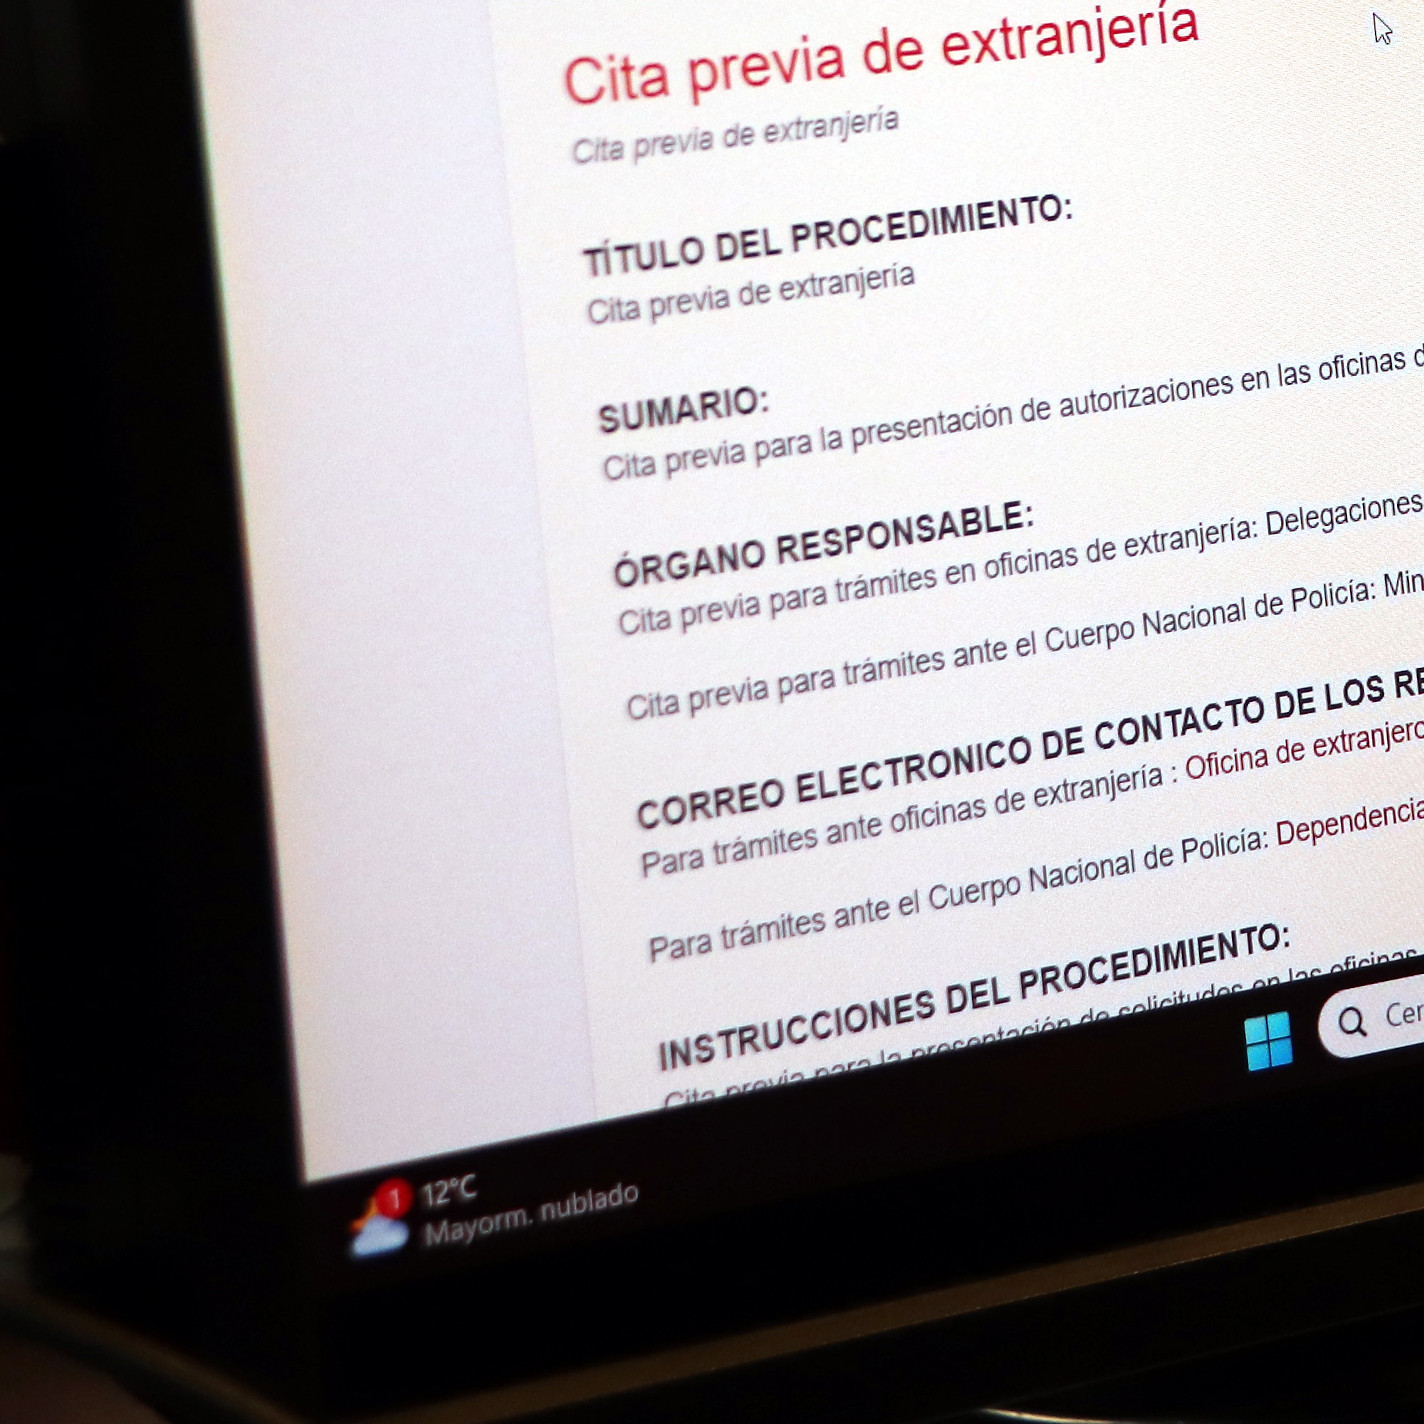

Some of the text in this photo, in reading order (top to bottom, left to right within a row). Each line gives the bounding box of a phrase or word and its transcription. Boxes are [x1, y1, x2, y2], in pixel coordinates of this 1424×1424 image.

[564, 53, 669, 106] Cita
[688, 35, 845, 107] previa
[863, 26, 924, 75] de
[582, 193, 1072, 277] TÍTULO DEL PROCEDIMIENTO:
[587, 265, 916, 326] Cita previa de extranjería
[598, 385, 769, 435] SUMARIO:
[602, 454, 657, 482] Cita
[664, 443, 747, 480] previa
[754, 433, 813, 468] para
[819, 427, 844, 451] la
[850, 406, 1014, 454] presentación
[1020, 398, 1052, 423] de
[1059, 374, 1235, 418] autorizaciones
[1240, 370, 1271, 392] en
[1277, 363, 1312, 386] las
[1318, 350, 1407, 381] oficinas
[613, 500, 1034, 589] ÓRGANO RESPONSABLE:
[618, 608, 672, 637] Cita
[679, 595, 761, 634] previa
[769, 585, 828, 620] para
[835, 568, 938, 603] trámites
[944, 562, 977, 586] en
[984, 546, 1079, 580] oficinas
[1085, 539, 1117, 564] de
[1124, 516, 1257, 558] extranjería:
[1265, 493, 1424, 536] Delegaciones
[626, 693, 680, 721] Cita
[688, 679, 769, 718] previa
[777, 668, 836, 704] para
[842, 650, 946, 686] trámites
[953, 639, 1008, 669] ante
[1015, 631, 1037, 657] el
[1044, 620, 1135, 652] Cuerpo
[1141, 597, 1247, 637] Nacional
[1253, 593, 1284, 618] de
[1291, 582, 1376, 612] Policía:
[636, 778, 785, 830] CORREO
[795, 735, 1032, 804] ELECTRONICO
[1042, 725, 1085, 760] DE
[1094, 695, 1265, 750] CONTACTO
[1274, 685, 1316, 720] DE
[1324, 674, 1386, 711] LOS
[641, 848, 705, 879] Para
[712, 828, 819, 866] trámites
[826, 816, 883, 846] ante
[889, 798, 987, 834] oficinas
[994, 789, 1025, 815] de
[1033, 767, 1163, 808] extranjería
[1185, 747, 1269, 780] Oficina
[1275, 739, 1305, 765] de
[649, 932, 713, 964] Para
[720, 912, 827, 950] trámites
[834, 899, 891, 929] ante
[898, 889, 920, 917] el
[928, 876, 1022, 910] Cuerpo
[1028, 849, 1136, 892] Nacional
[1143, 845, 1174, 871] de
[1180, 828, 1268, 864] Policía:
[658, 922, 1290, 1072] INSTRUCCIONES DEL PROCEDIMIENTO:
[424, 1182, 639, 1247] Mayorm. nublado
